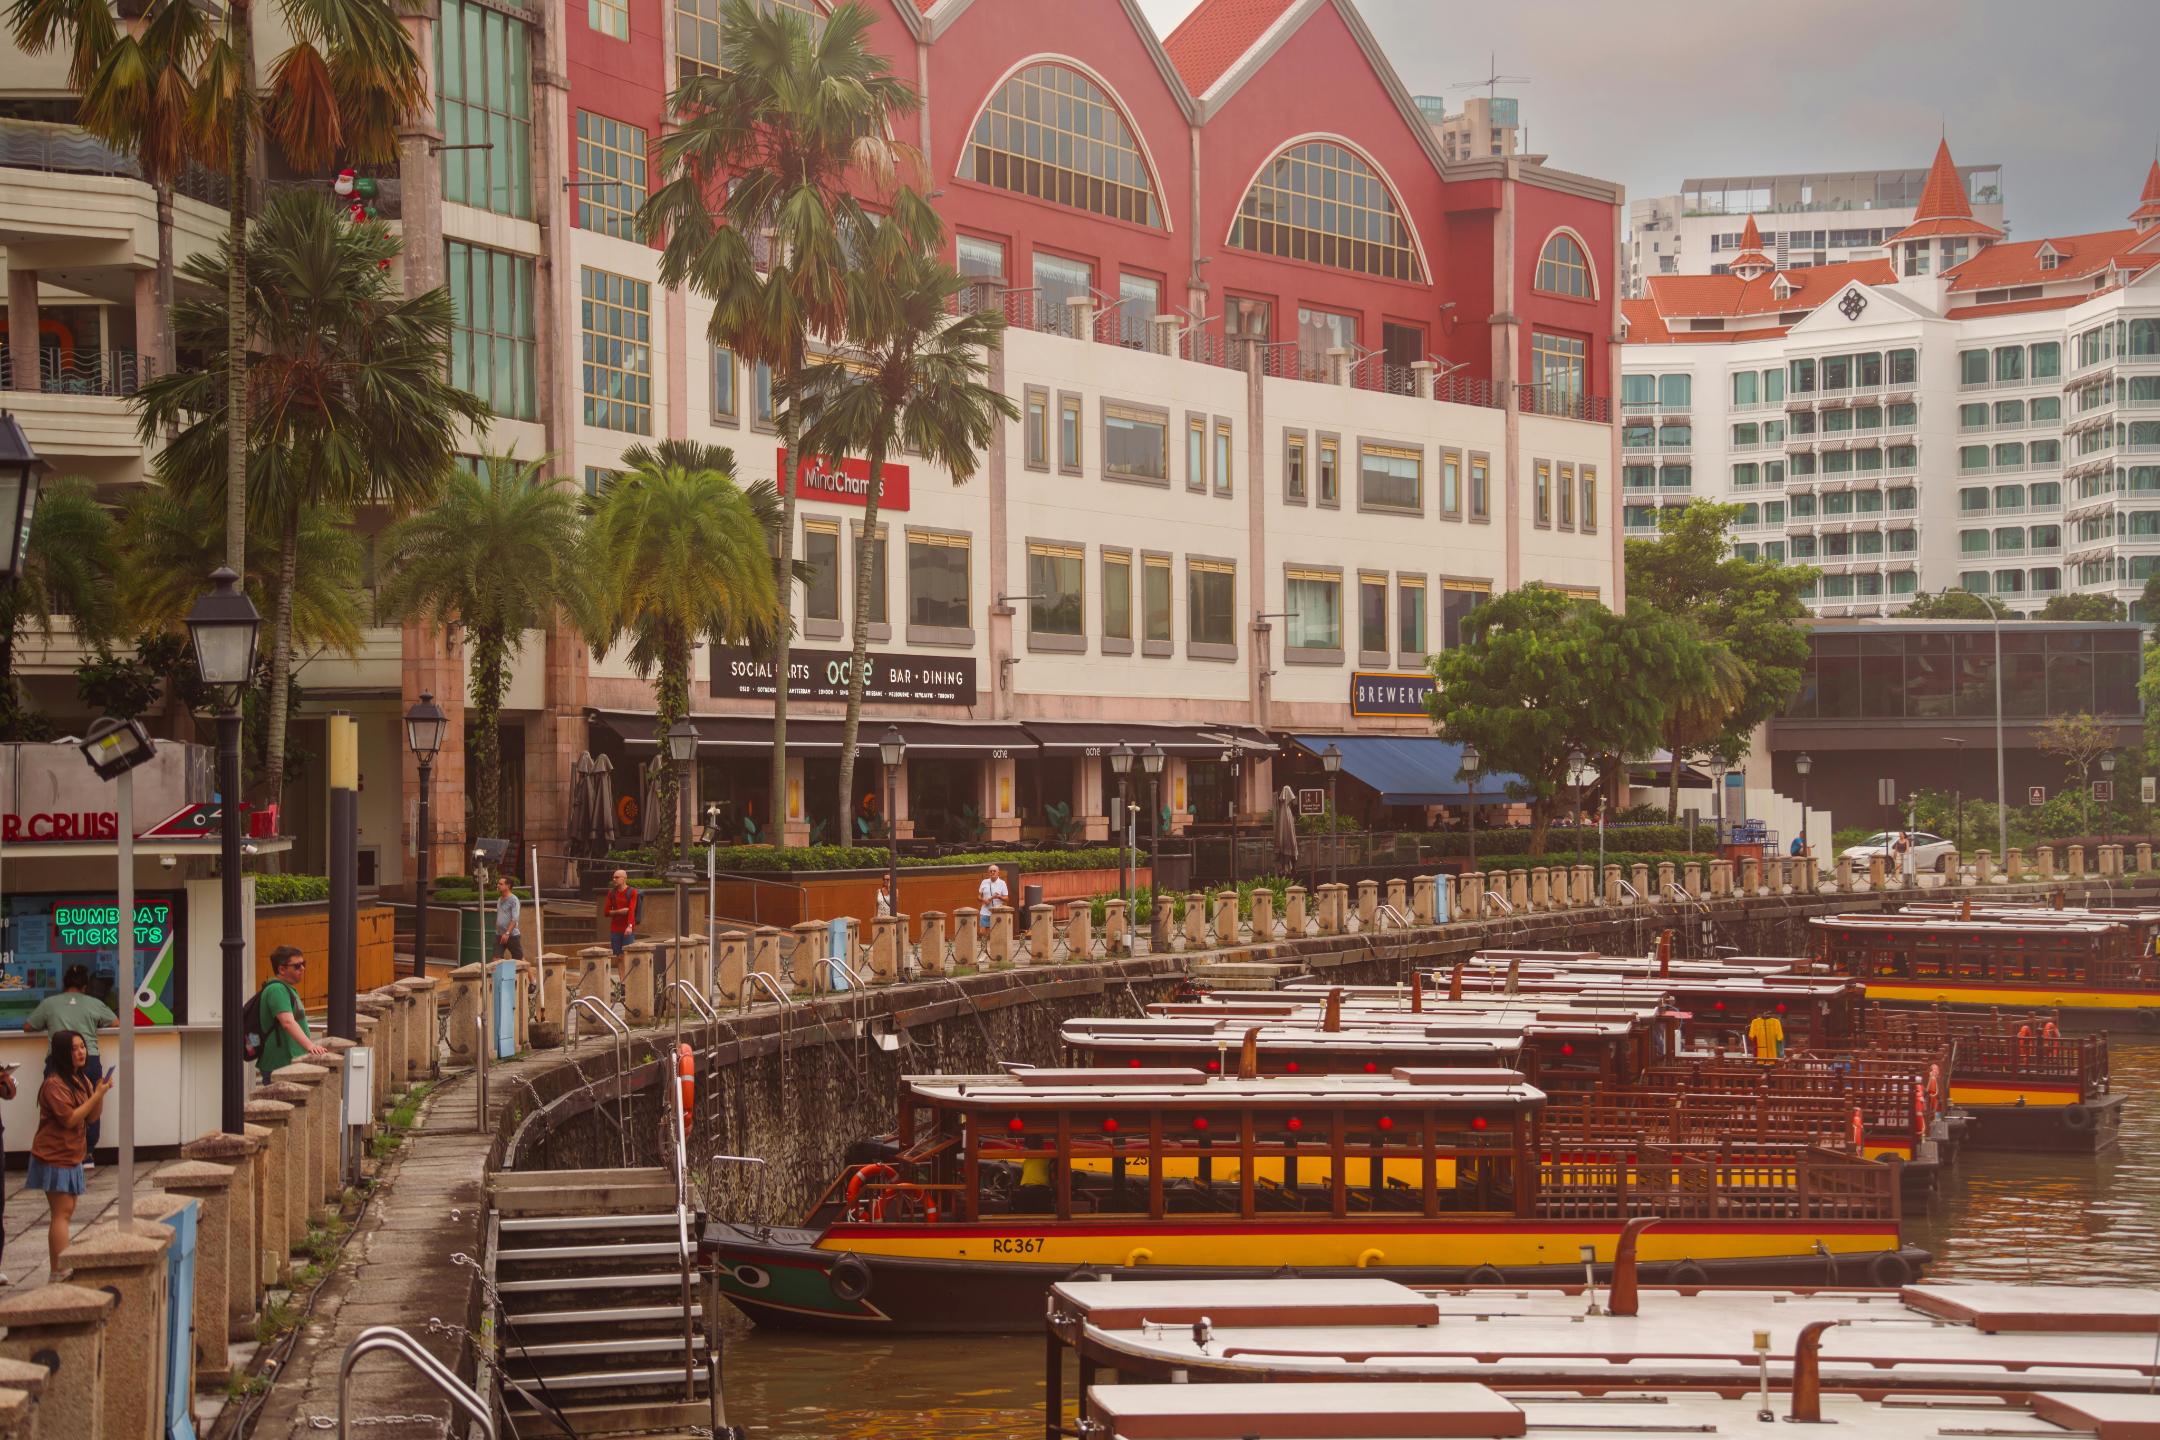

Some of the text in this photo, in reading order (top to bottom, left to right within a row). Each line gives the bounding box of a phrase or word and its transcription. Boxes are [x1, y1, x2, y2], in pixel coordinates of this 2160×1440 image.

[804, 466, 885, 497] MindChams
[731, 661, 810, 679] SOCIAL RTS
[890, 668, 963, 685] BAR DINING
[55, 906, 169, 926] BUMBAT
[61, 927, 163, 945] TICKTS
[993, 1238, 1045, 1253] RC367
